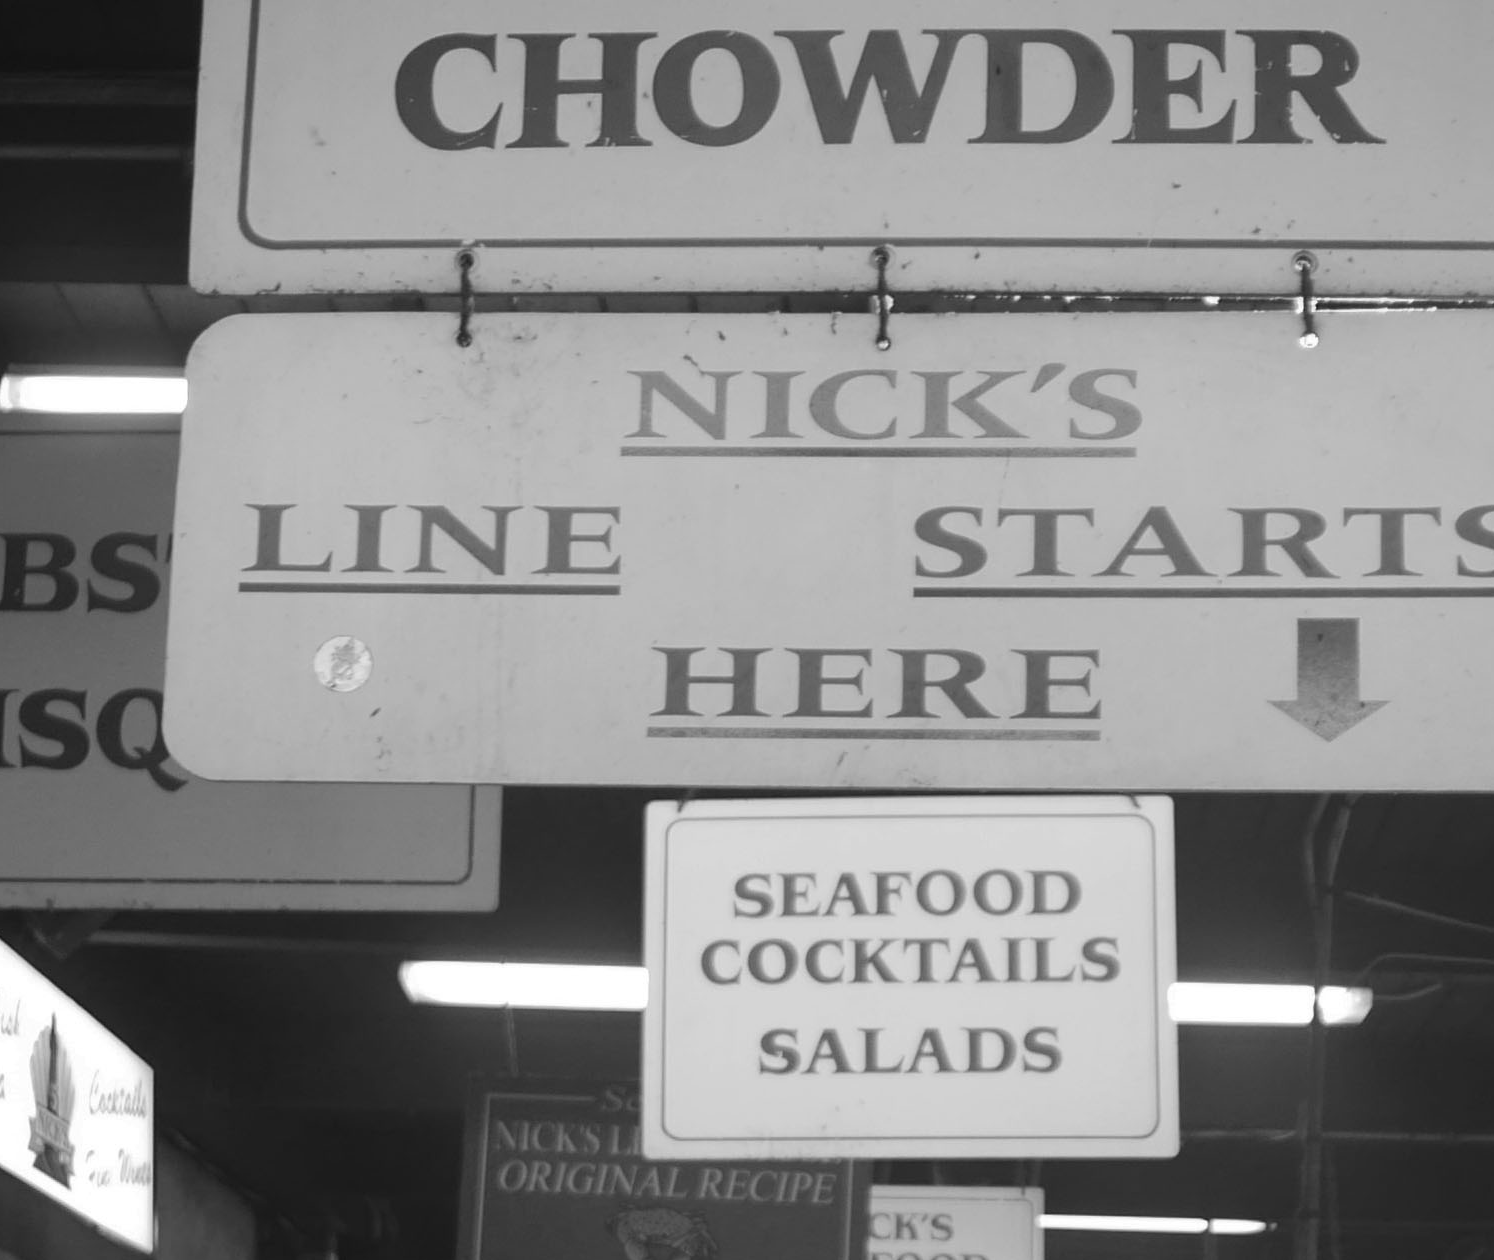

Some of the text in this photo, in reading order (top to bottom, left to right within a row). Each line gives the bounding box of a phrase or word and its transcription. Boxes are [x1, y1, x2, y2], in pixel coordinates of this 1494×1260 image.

[395, 29, 1386, 150] CHOWDER
[624, 363, 1143, 443] NICK'S
[242, 503, 622, 576] LINE
[649, 647, 1102, 720] HERE
[732, 868, 1083, 919] SEAFOOD
[700, 936, 1121, 985] COCKTAILS
[758, 1026, 1063, 1075] SALADS
[493, 1120, 602, 1154] NICK'S
[497, 1159, 838, 1205] ORIGINAL RECIPE
[868, 1212, 954, 1242] CK'S
